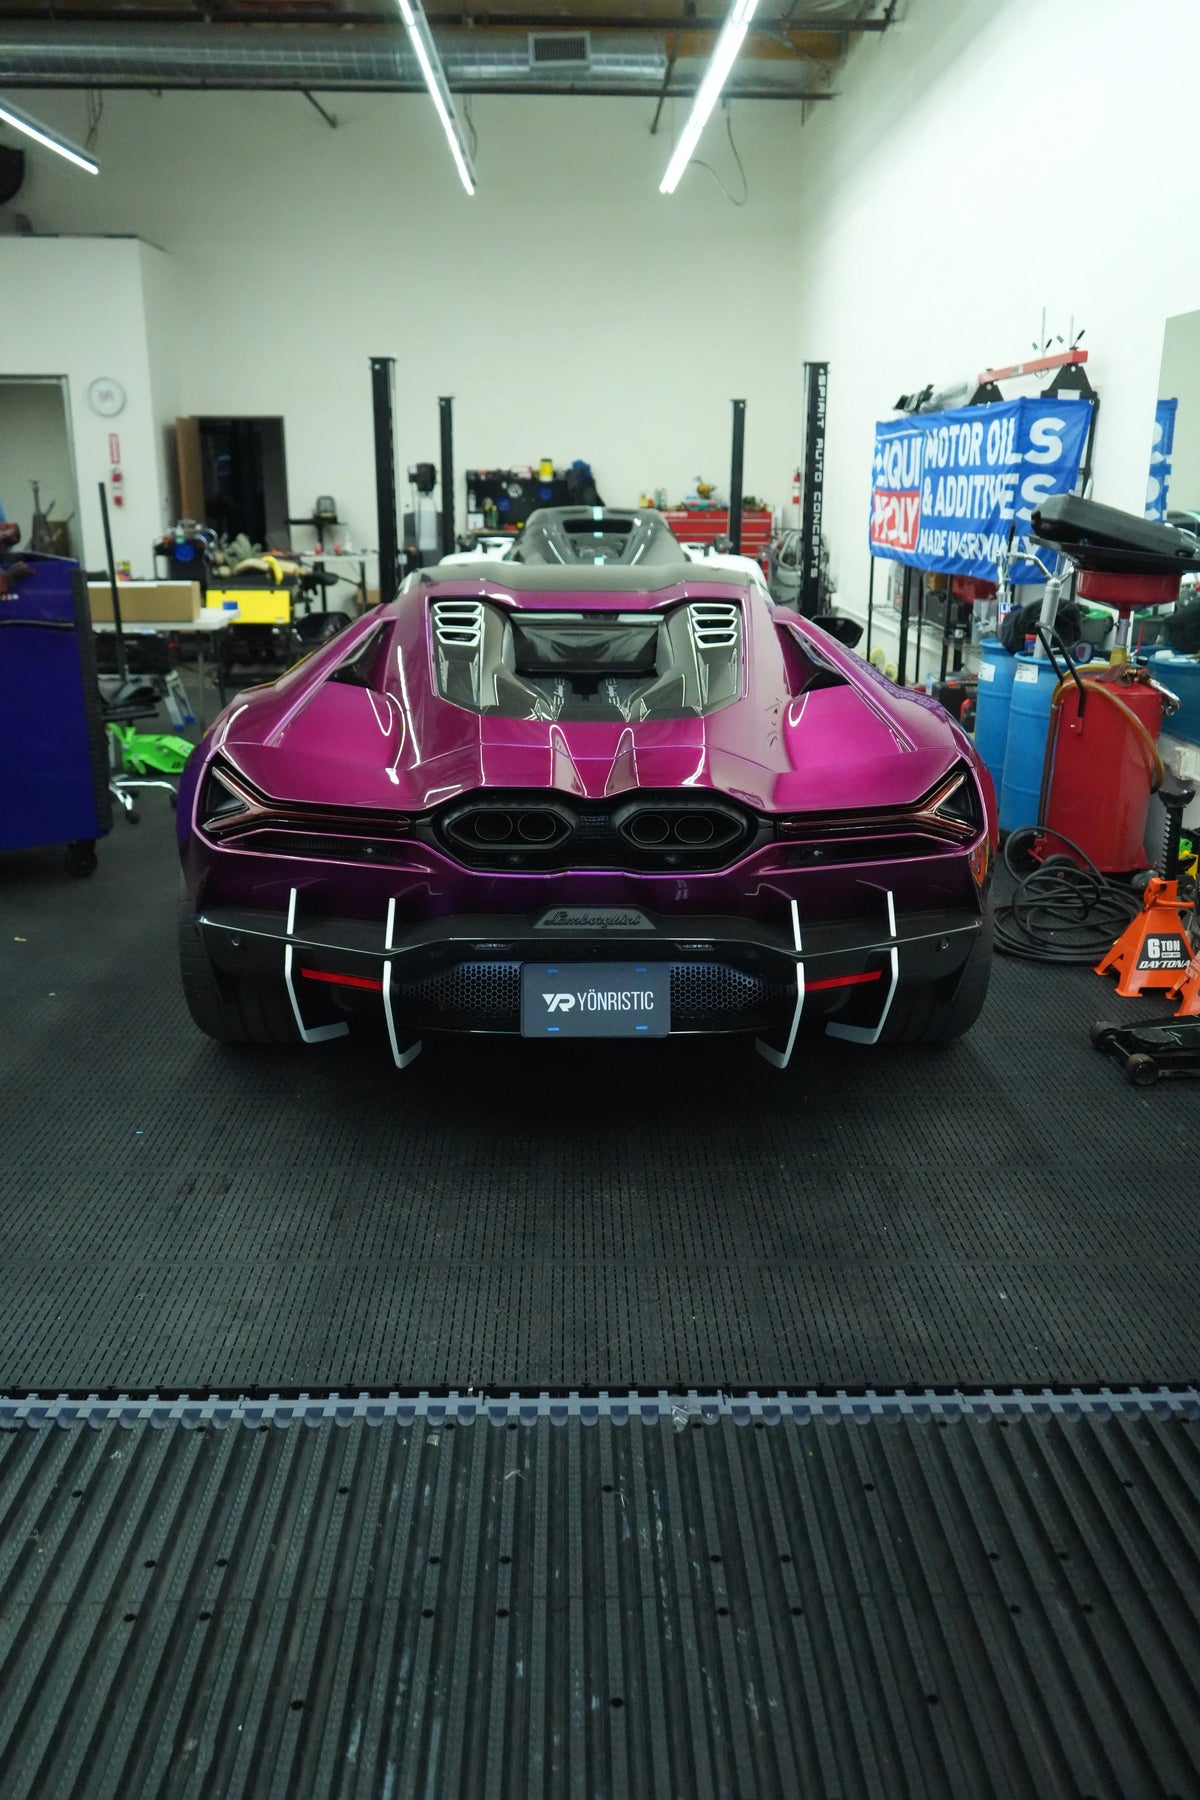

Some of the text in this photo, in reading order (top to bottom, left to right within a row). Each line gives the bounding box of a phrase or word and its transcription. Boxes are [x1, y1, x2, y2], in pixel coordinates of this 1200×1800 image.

[924, 417, 1066, 468] MOTOR OILS
[810, 374, 827, 578] SPIRIT AUTO CONCEPTS
[922, 473, 1057, 522] & ADDITIVES
[918, 528, 947, 557] MADE
[947, 530, 960, 558] IN
[543, 911, 641, 929] Lamborghini
[1147, 938, 1161, 959] 6
[1161, 940, 1181, 952] TON
[1139, 959, 1192, 969] DAYTONA
[577, 988, 654, 1012] YÖNRISTIC
